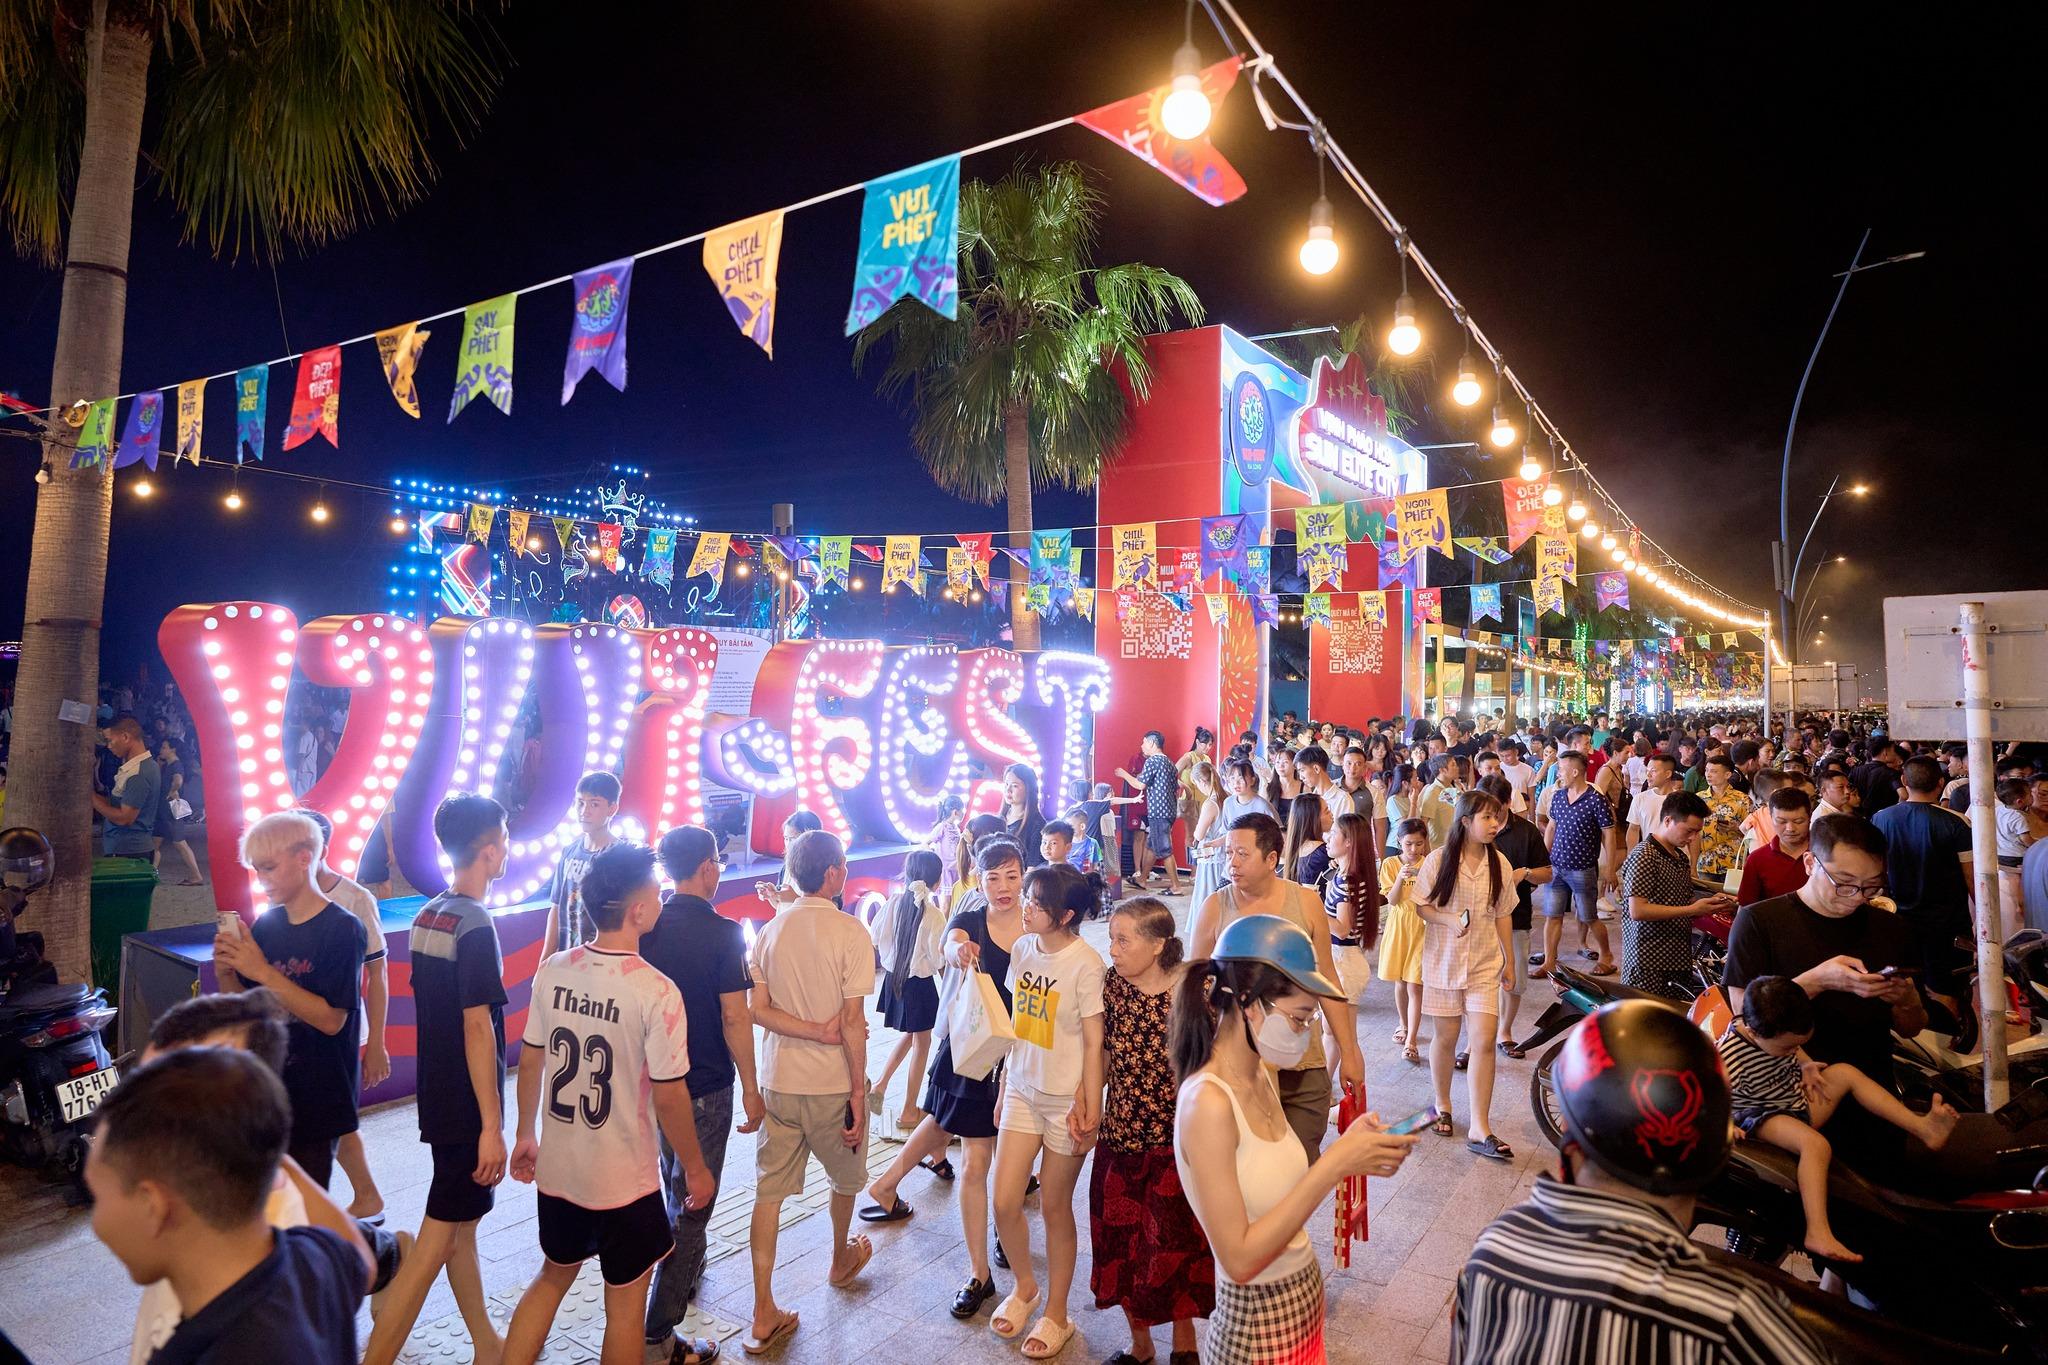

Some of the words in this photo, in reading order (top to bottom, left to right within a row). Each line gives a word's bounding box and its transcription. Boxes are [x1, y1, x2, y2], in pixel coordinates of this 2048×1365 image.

[889, 184, 931, 222] VUI
[728, 230, 762, 262] CHILL
[474, 310, 498, 336] SAY
[1304, 432, 1338, 474] SUN
[1341, 447, 1376, 490] ELITE
[1376, 470, 1400, 500] CITY
[1405, 498, 1432, 510] NGON
[1308, 512, 1330, 527] SAY
[827, 541, 841, 552] SAY
[893, 543, 911, 551] NGON
[1042, 537, 1061, 549] VUI
[1123, 528, 1146, 540] CHILL
[1160, 564, 1174, 576] MUA
[1019, 971, 1058, 998] SAY
[552, 985, 621, 1025] Thành
[66, 1071, 110, 1100] 18-H1
[549, 1025, 614, 1130] 23
